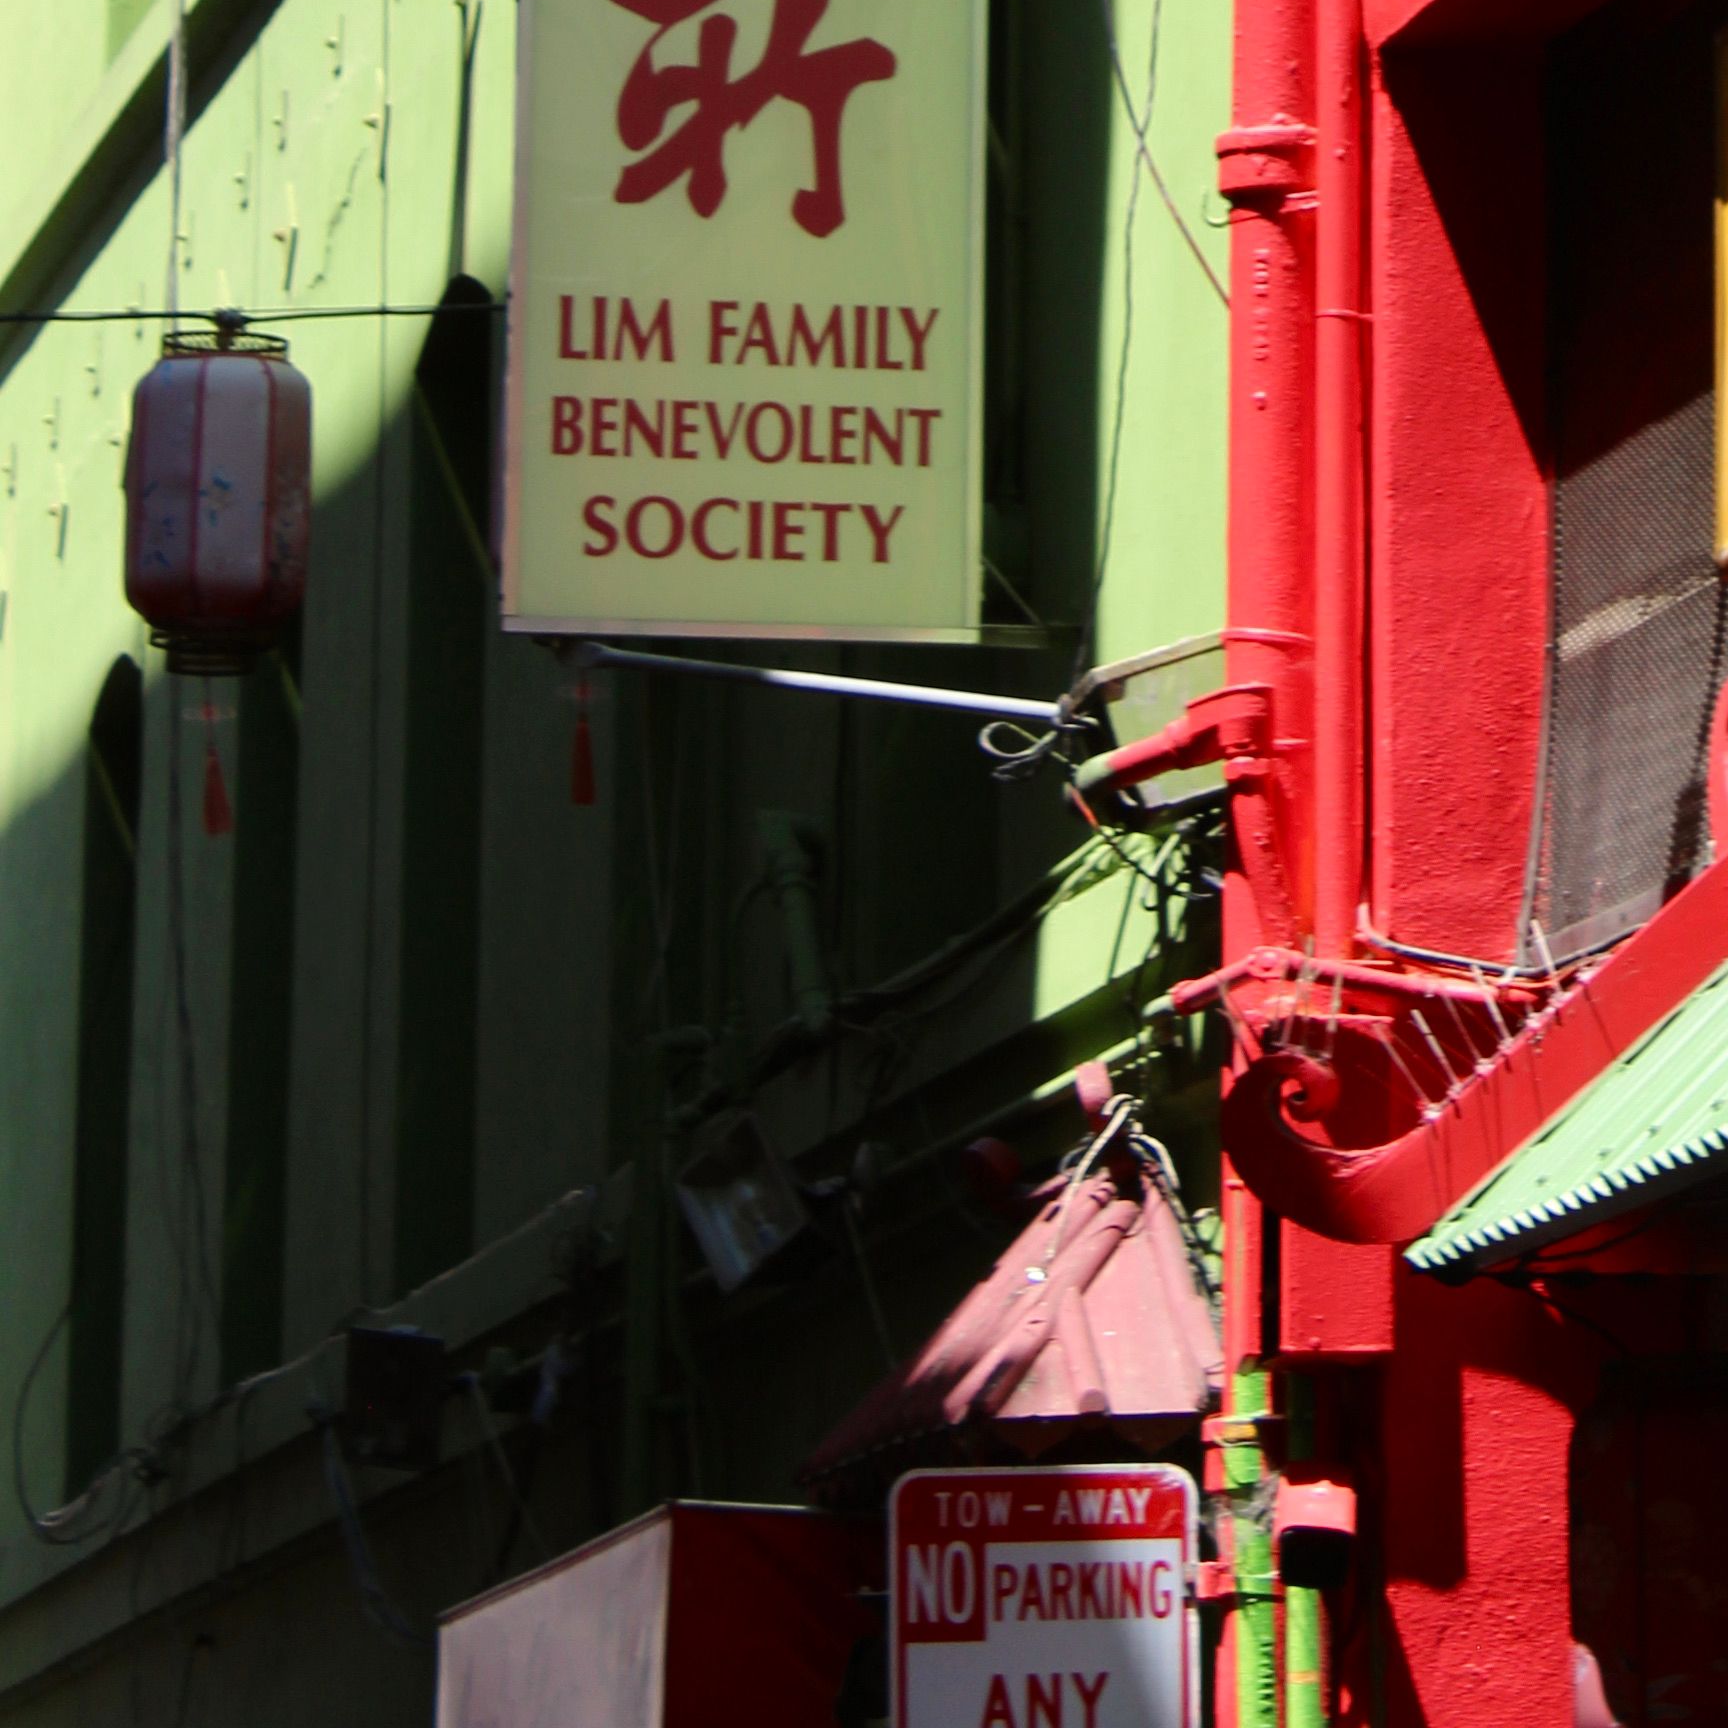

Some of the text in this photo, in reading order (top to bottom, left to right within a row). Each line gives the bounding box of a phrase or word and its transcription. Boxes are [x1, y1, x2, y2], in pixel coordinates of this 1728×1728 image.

[556, 294, 940, 373] LIM FAMILY
[550, 395, 942, 469] BENEVOLENT
[580, 493, 906, 566] SOCIETY
[906, 1542, 1173, 1625] NO PARKING
[980, 1671, 1110, 1728] ANY
